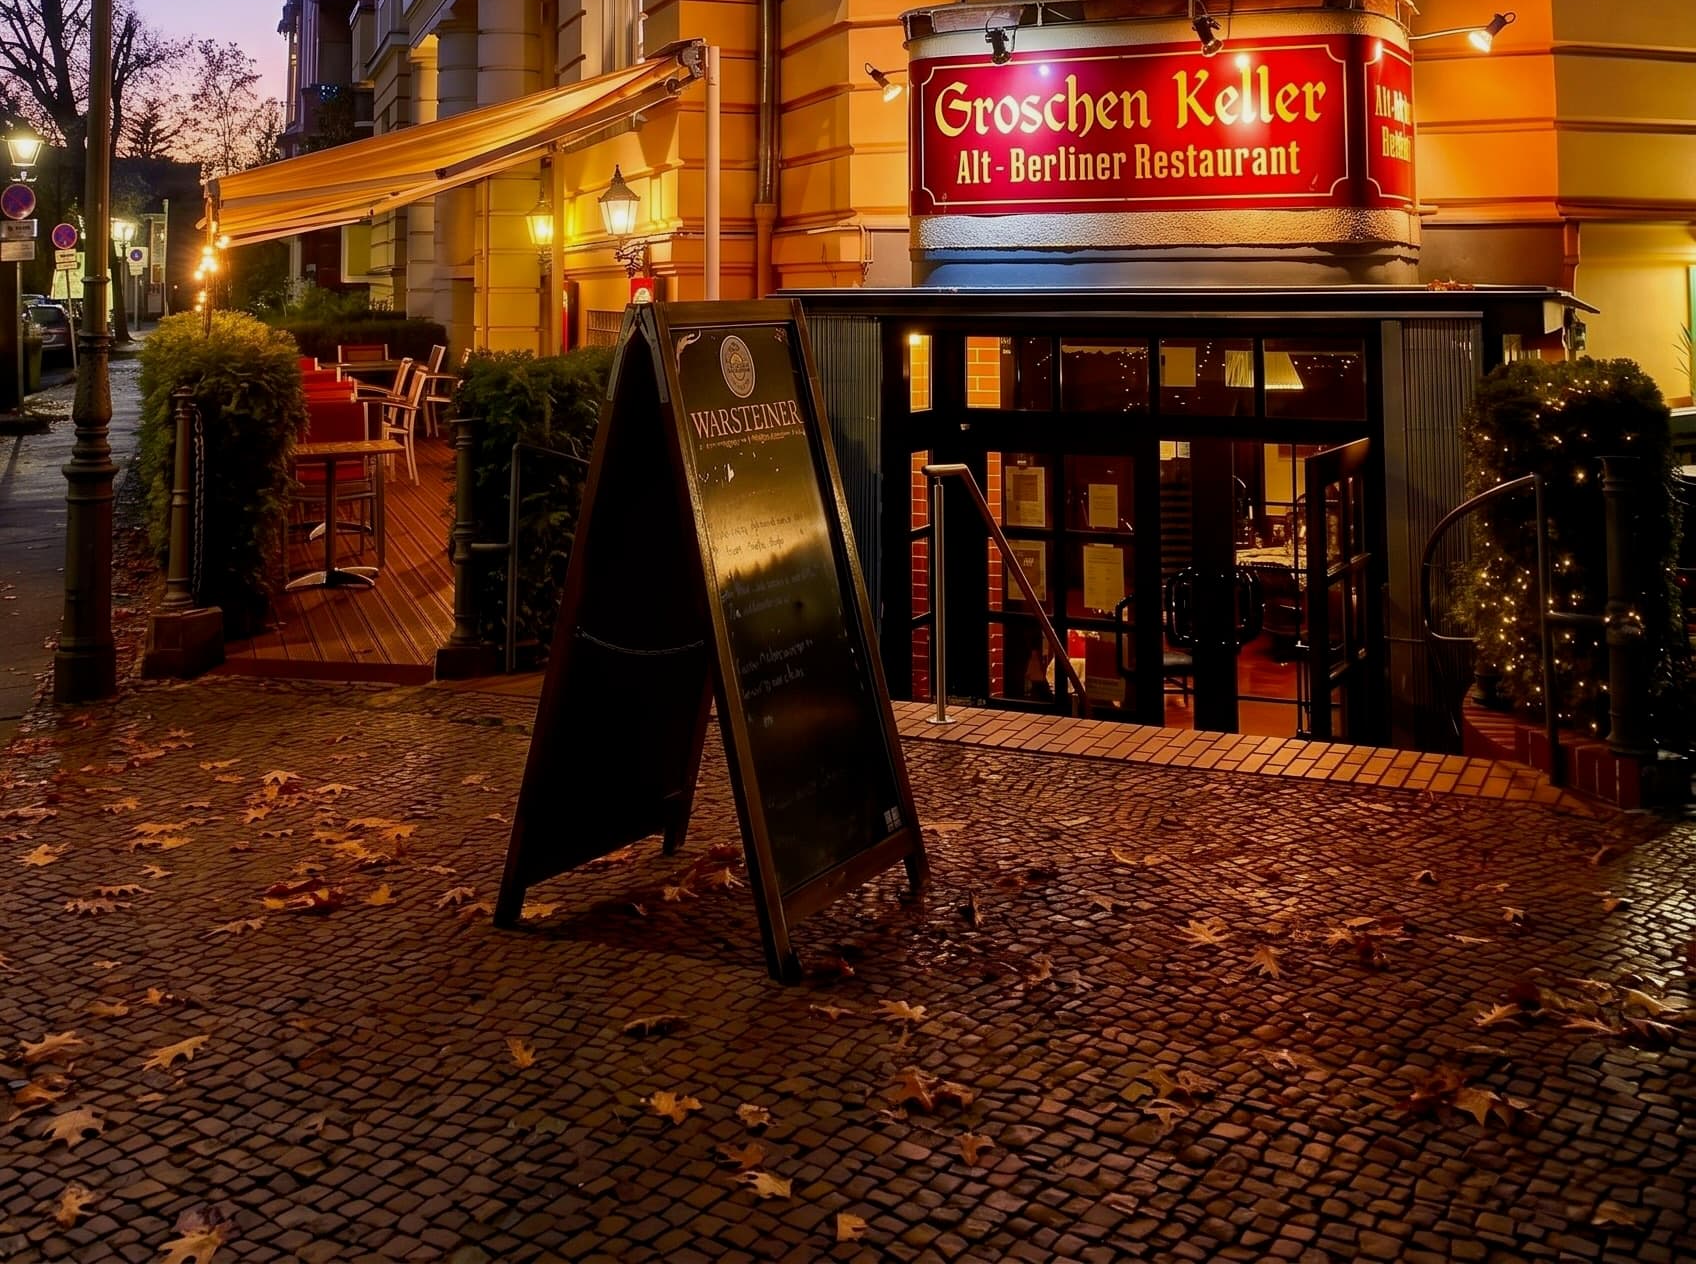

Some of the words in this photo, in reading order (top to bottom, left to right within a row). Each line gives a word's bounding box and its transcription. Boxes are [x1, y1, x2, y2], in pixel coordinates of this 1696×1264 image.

[935, 74, 1151, 137] Groschen
[1172, 64, 1327, 128] Keller
[1134, 141, 1301, 179] Restaurant
[690, 400, 804, 439] WARSTEINER
